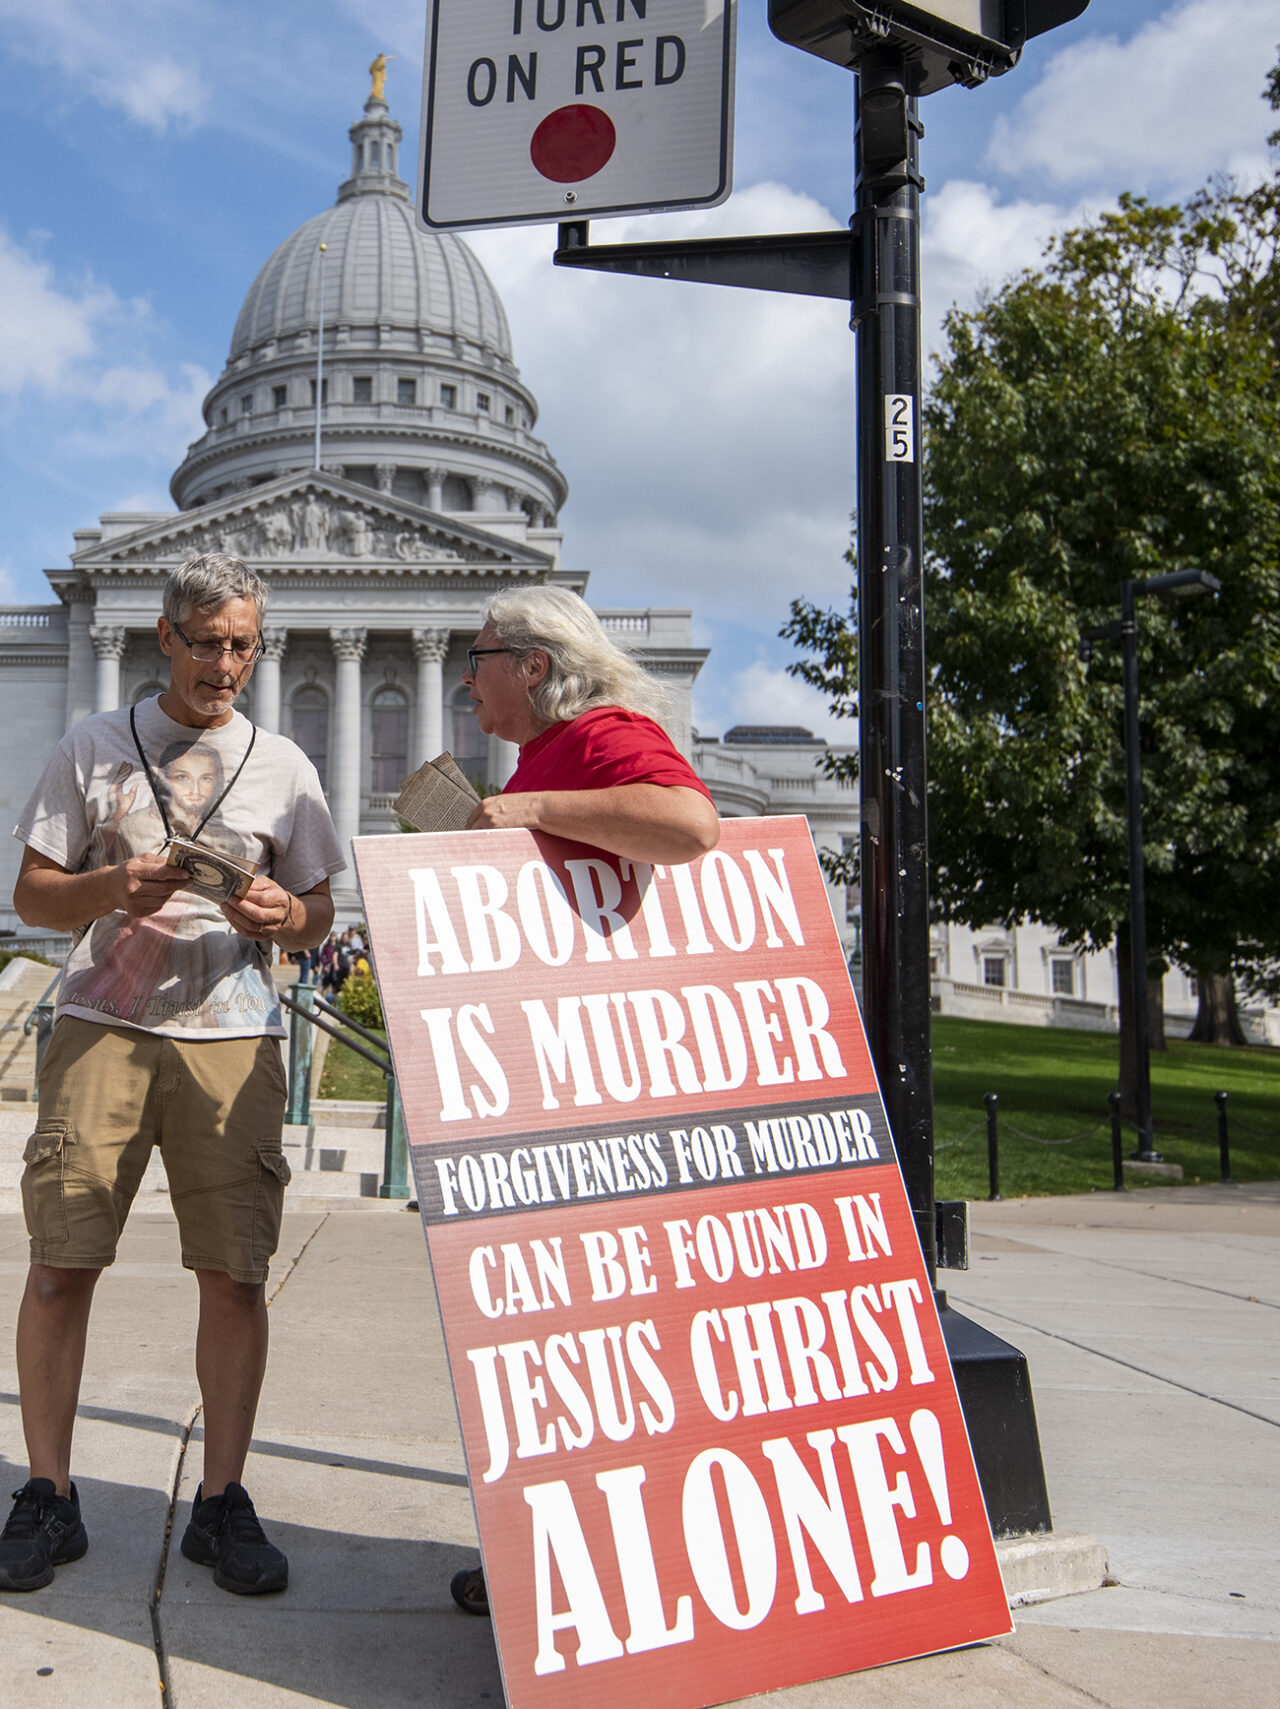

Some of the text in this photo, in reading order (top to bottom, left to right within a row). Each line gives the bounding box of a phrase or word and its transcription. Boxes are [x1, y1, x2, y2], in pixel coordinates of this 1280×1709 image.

[467, 35, 686, 107] ON RED
[408, 848, 806, 977] ABORTION
[128, 995, 139, 1015] I
[147, 993, 203, 1017] Trust
[209, 995, 231, 1015] in
[235, 992, 266, 1014] You
[421, 976, 847, 1122] IS MURDER
[434, 1108, 880, 1216] FORGIVENESS FOR MURDER
[468, 1193, 893, 1318] CAN BE FOUND IN
[466, 1278, 935, 1483] JESUS CHRIST
[523, 1408, 970, 1676] ALONE!
